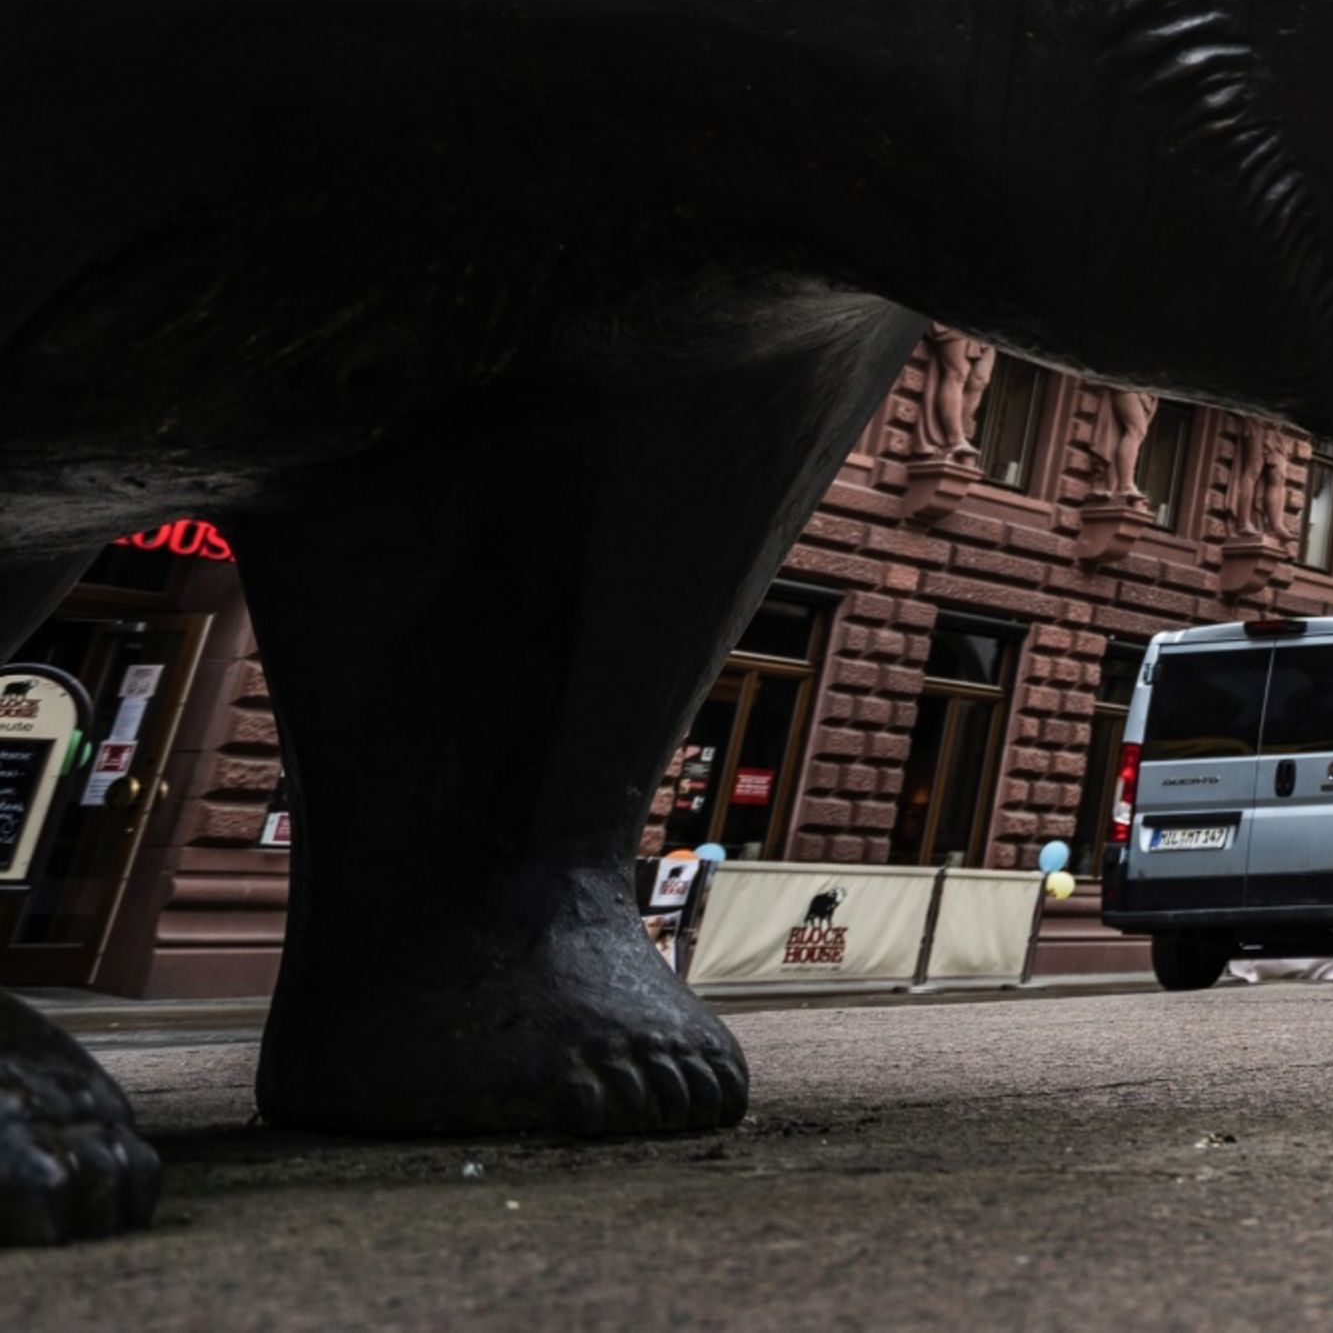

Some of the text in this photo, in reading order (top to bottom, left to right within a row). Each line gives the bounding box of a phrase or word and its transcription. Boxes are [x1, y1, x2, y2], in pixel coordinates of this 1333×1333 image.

[112, 518, 236, 562] OUS
[786, 926, 849, 945] BLOCK
[782, 946, 845, 964] HOUSE
